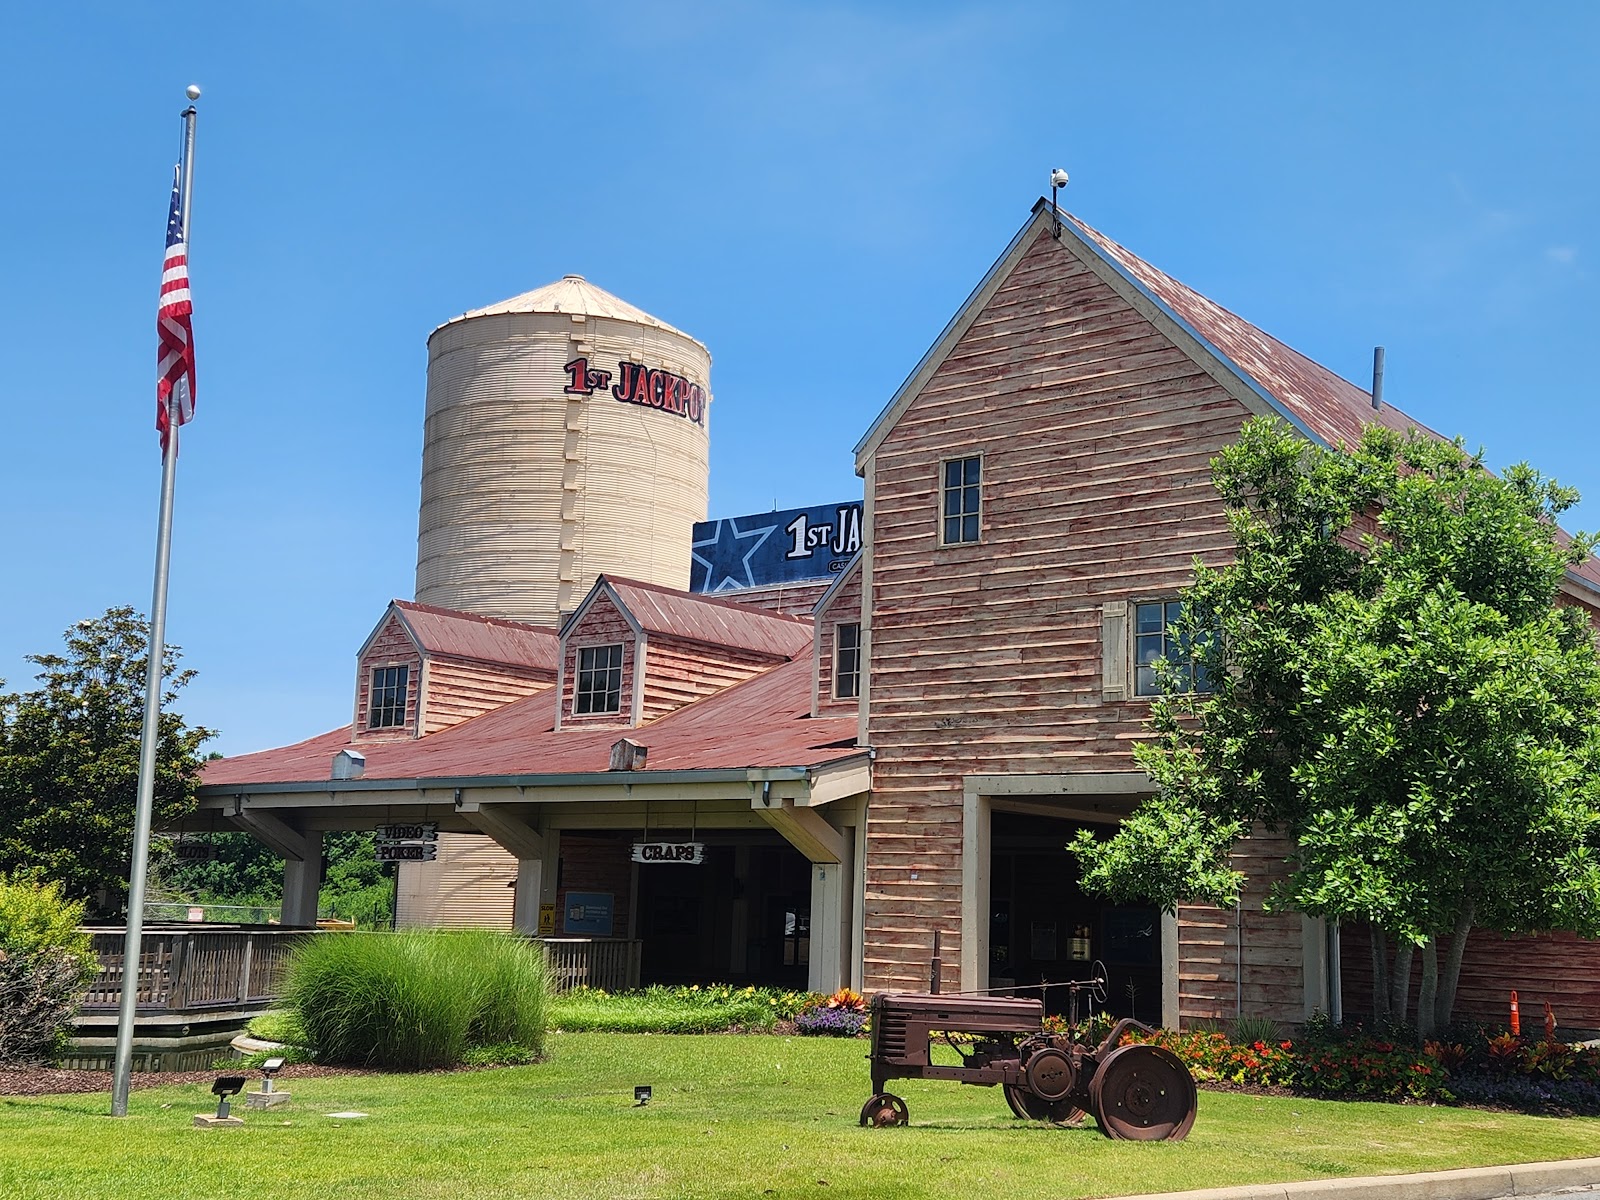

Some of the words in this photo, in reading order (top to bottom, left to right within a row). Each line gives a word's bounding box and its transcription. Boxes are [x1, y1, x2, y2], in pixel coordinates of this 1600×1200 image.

[612, 361, 706, 428] JACKPOT
[385, 826, 423, 838] VIDEO
[381, 847, 423, 859] POKER
[642, 845, 695, 860] CRAPS
